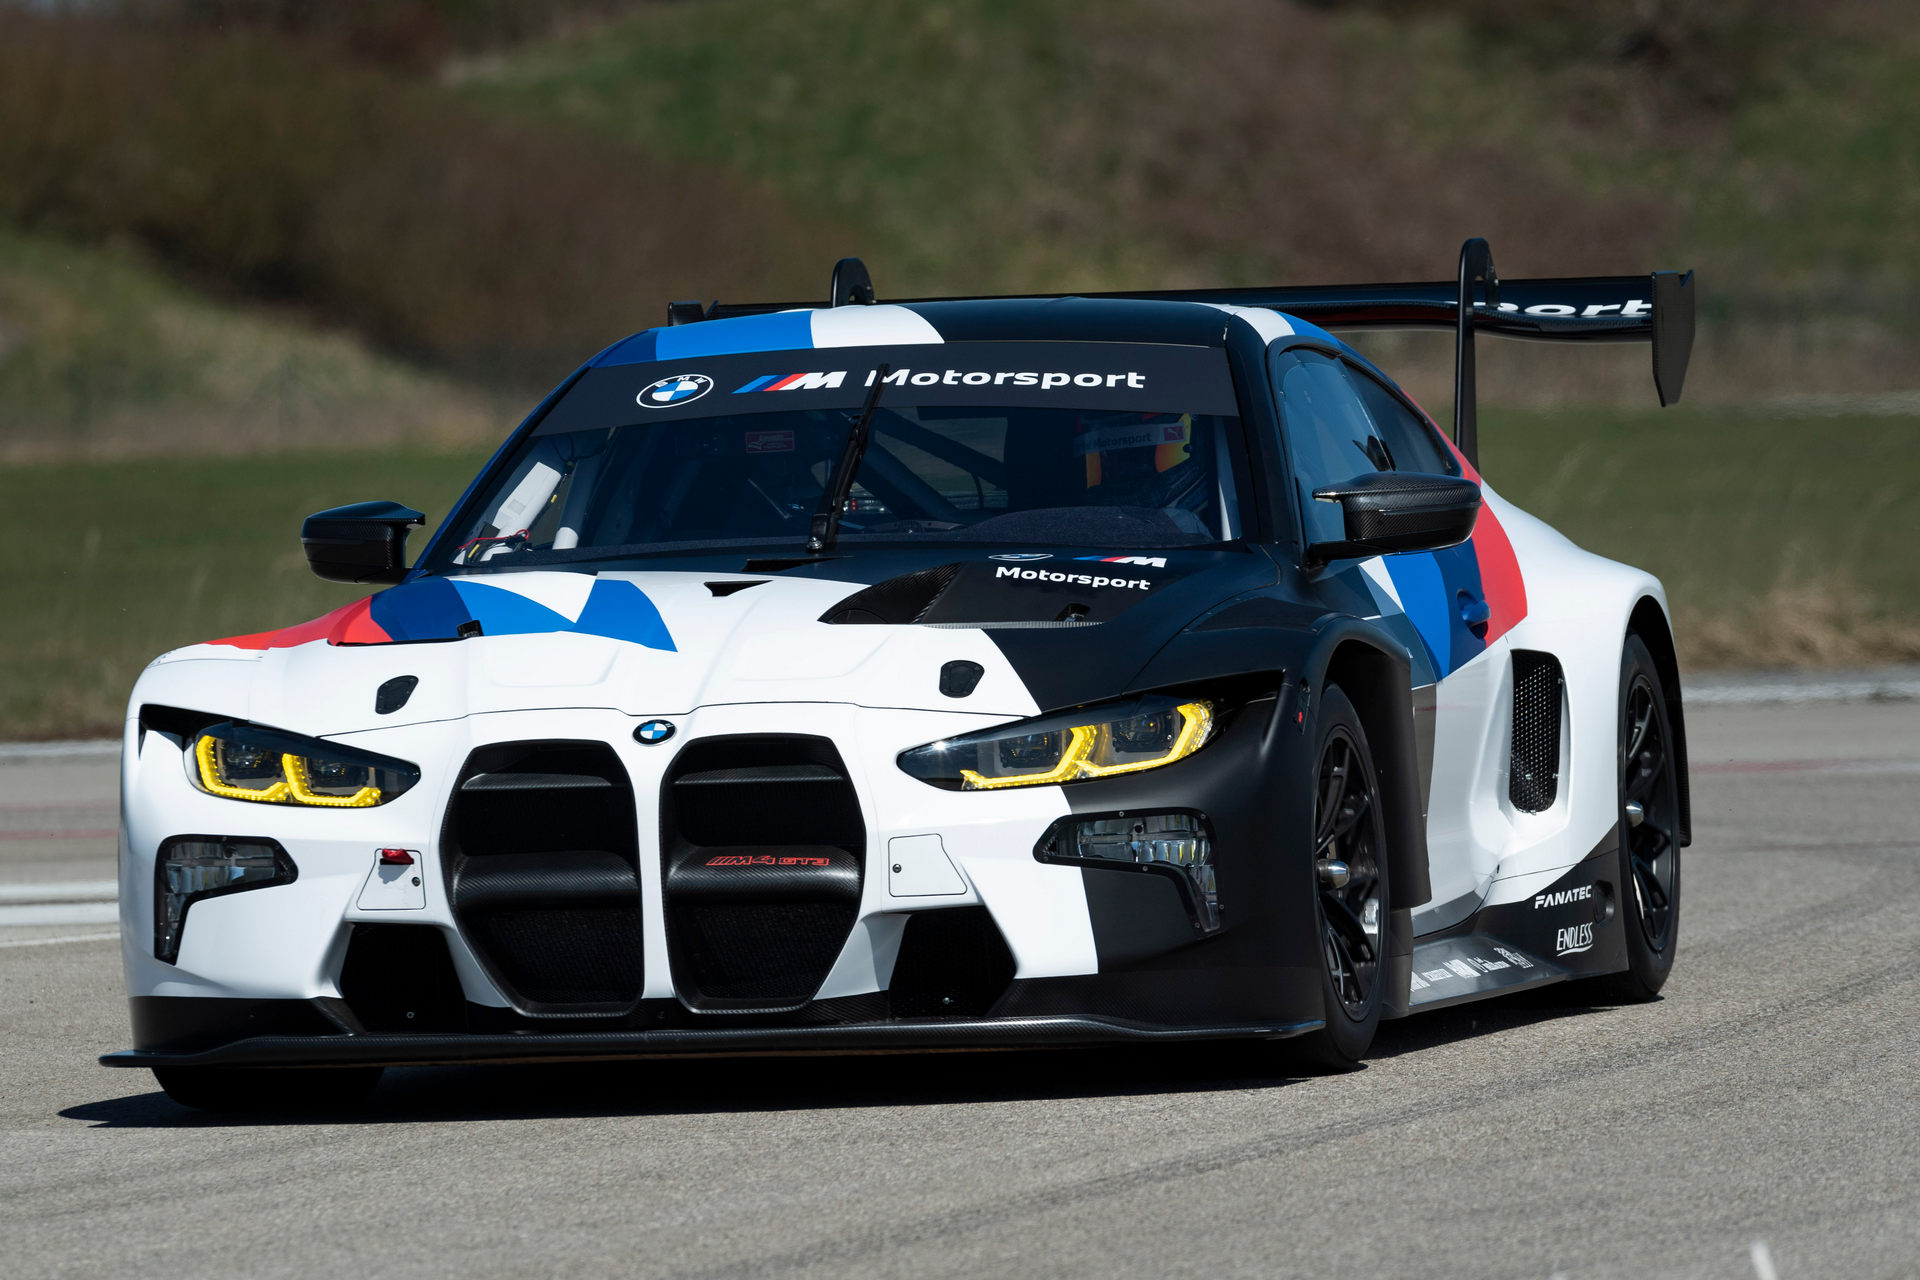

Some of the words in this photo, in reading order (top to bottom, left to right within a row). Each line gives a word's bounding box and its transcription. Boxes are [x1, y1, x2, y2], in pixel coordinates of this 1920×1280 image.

[864, 368, 1146, 390] Motorsport
[995, 566, 1151, 590] Motorsport
[778, 857, 829, 866] GT3
[1534, 884, 1592, 909] FANATEC
[1556, 922, 1593, 951] ENDLESS
